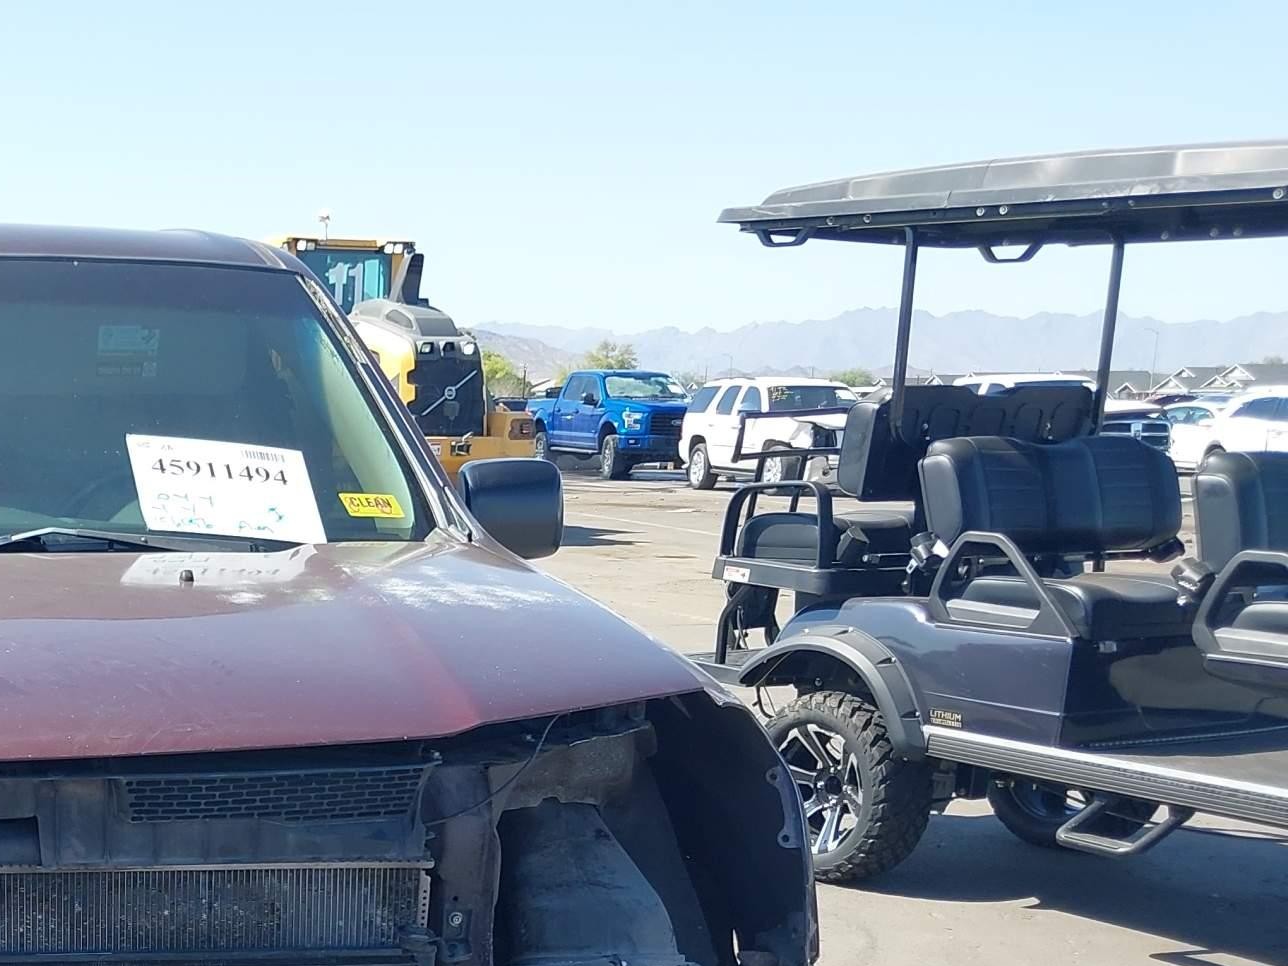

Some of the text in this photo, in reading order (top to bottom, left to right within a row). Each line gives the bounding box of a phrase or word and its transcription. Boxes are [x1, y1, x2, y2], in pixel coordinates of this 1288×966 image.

[151, 457, 289, 486] 45911494
[349, 496, 393, 509] CLEAN
[929, 709, 962, 722] LITHIUM
